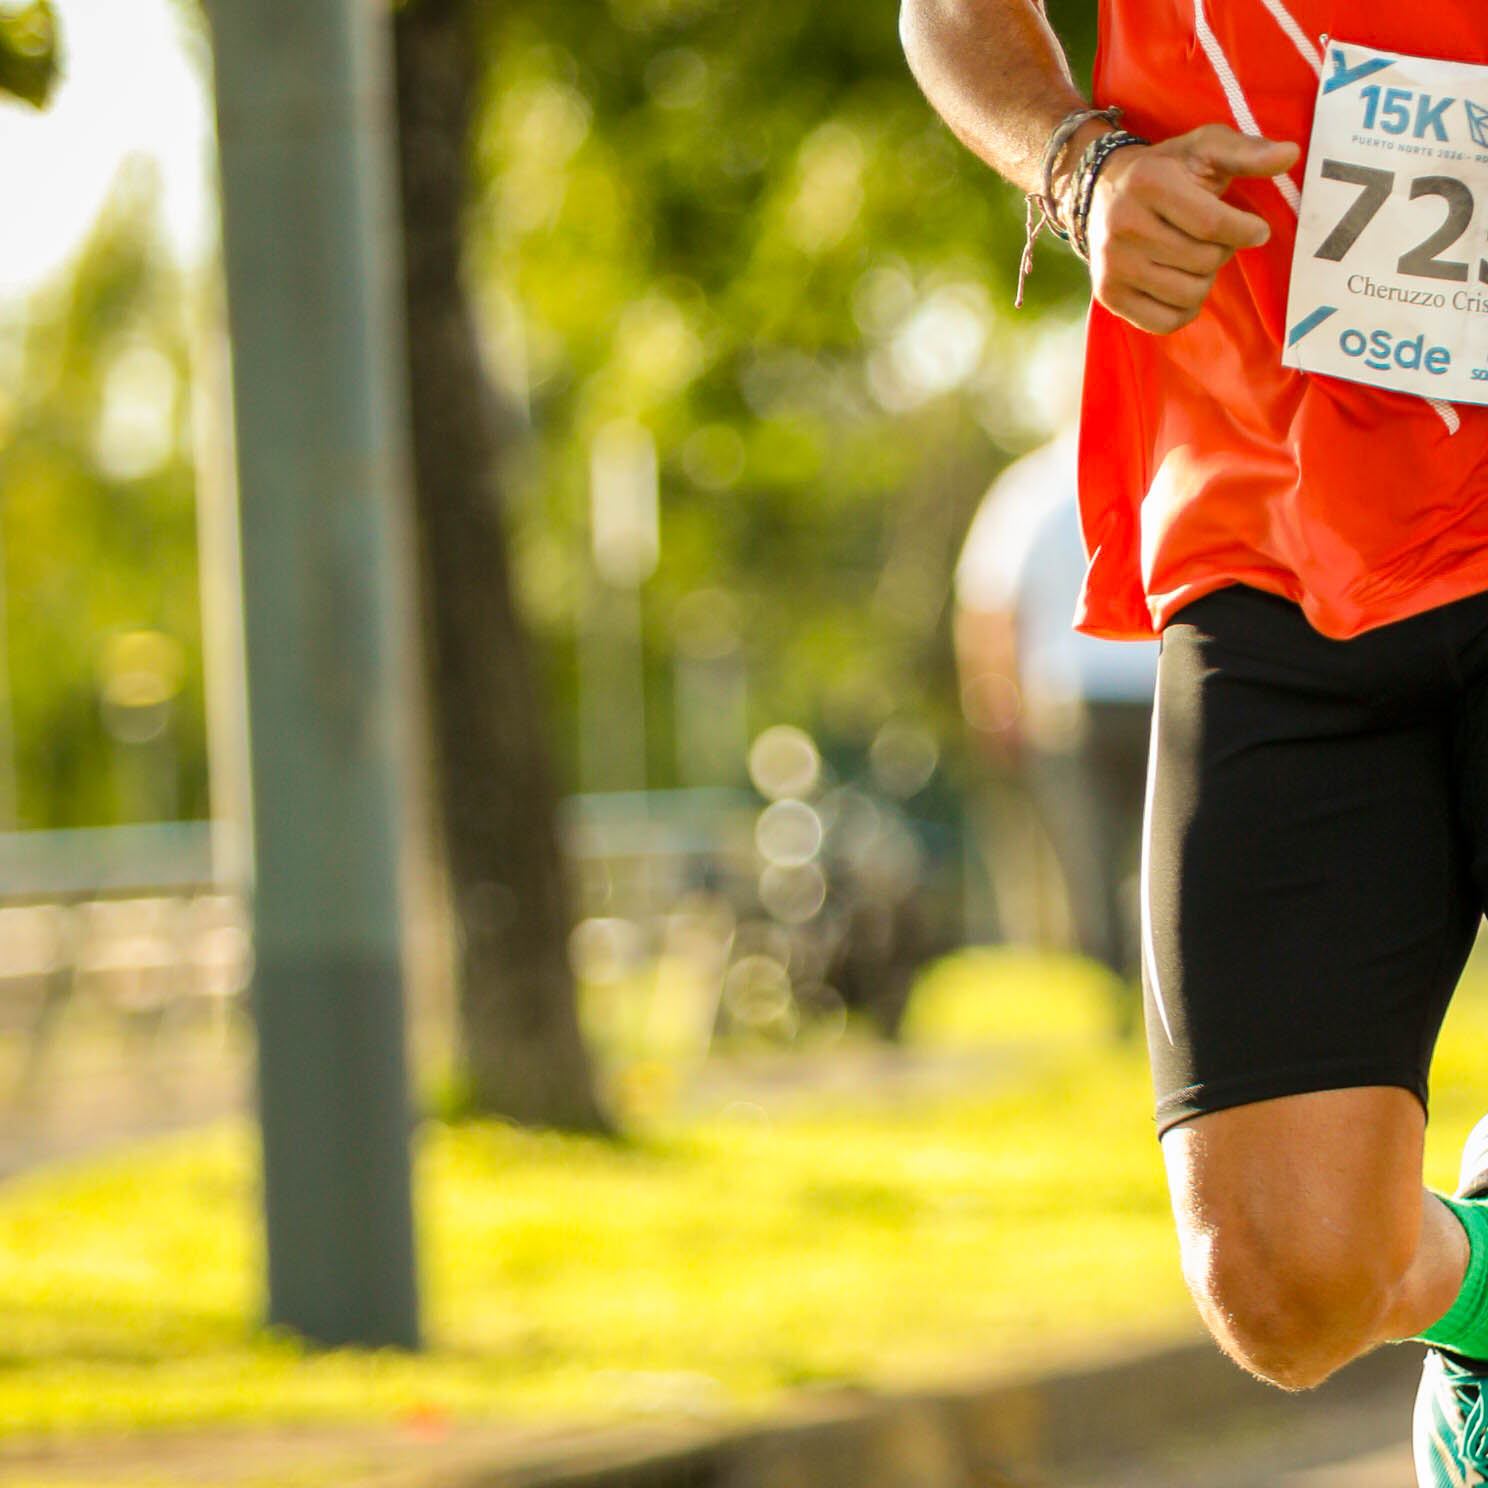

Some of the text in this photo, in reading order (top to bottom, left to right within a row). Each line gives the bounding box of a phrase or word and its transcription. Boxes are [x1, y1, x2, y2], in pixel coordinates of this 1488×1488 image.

[1360, 84, 1456, 142] 15K
[1351, 134, 1395, 150] PUERTO
[1397, 143, 1434, 157] NORTE
[1346, 273, 1446, 308] Cheruzzo
[1339, 328, 1451, 375] osde
